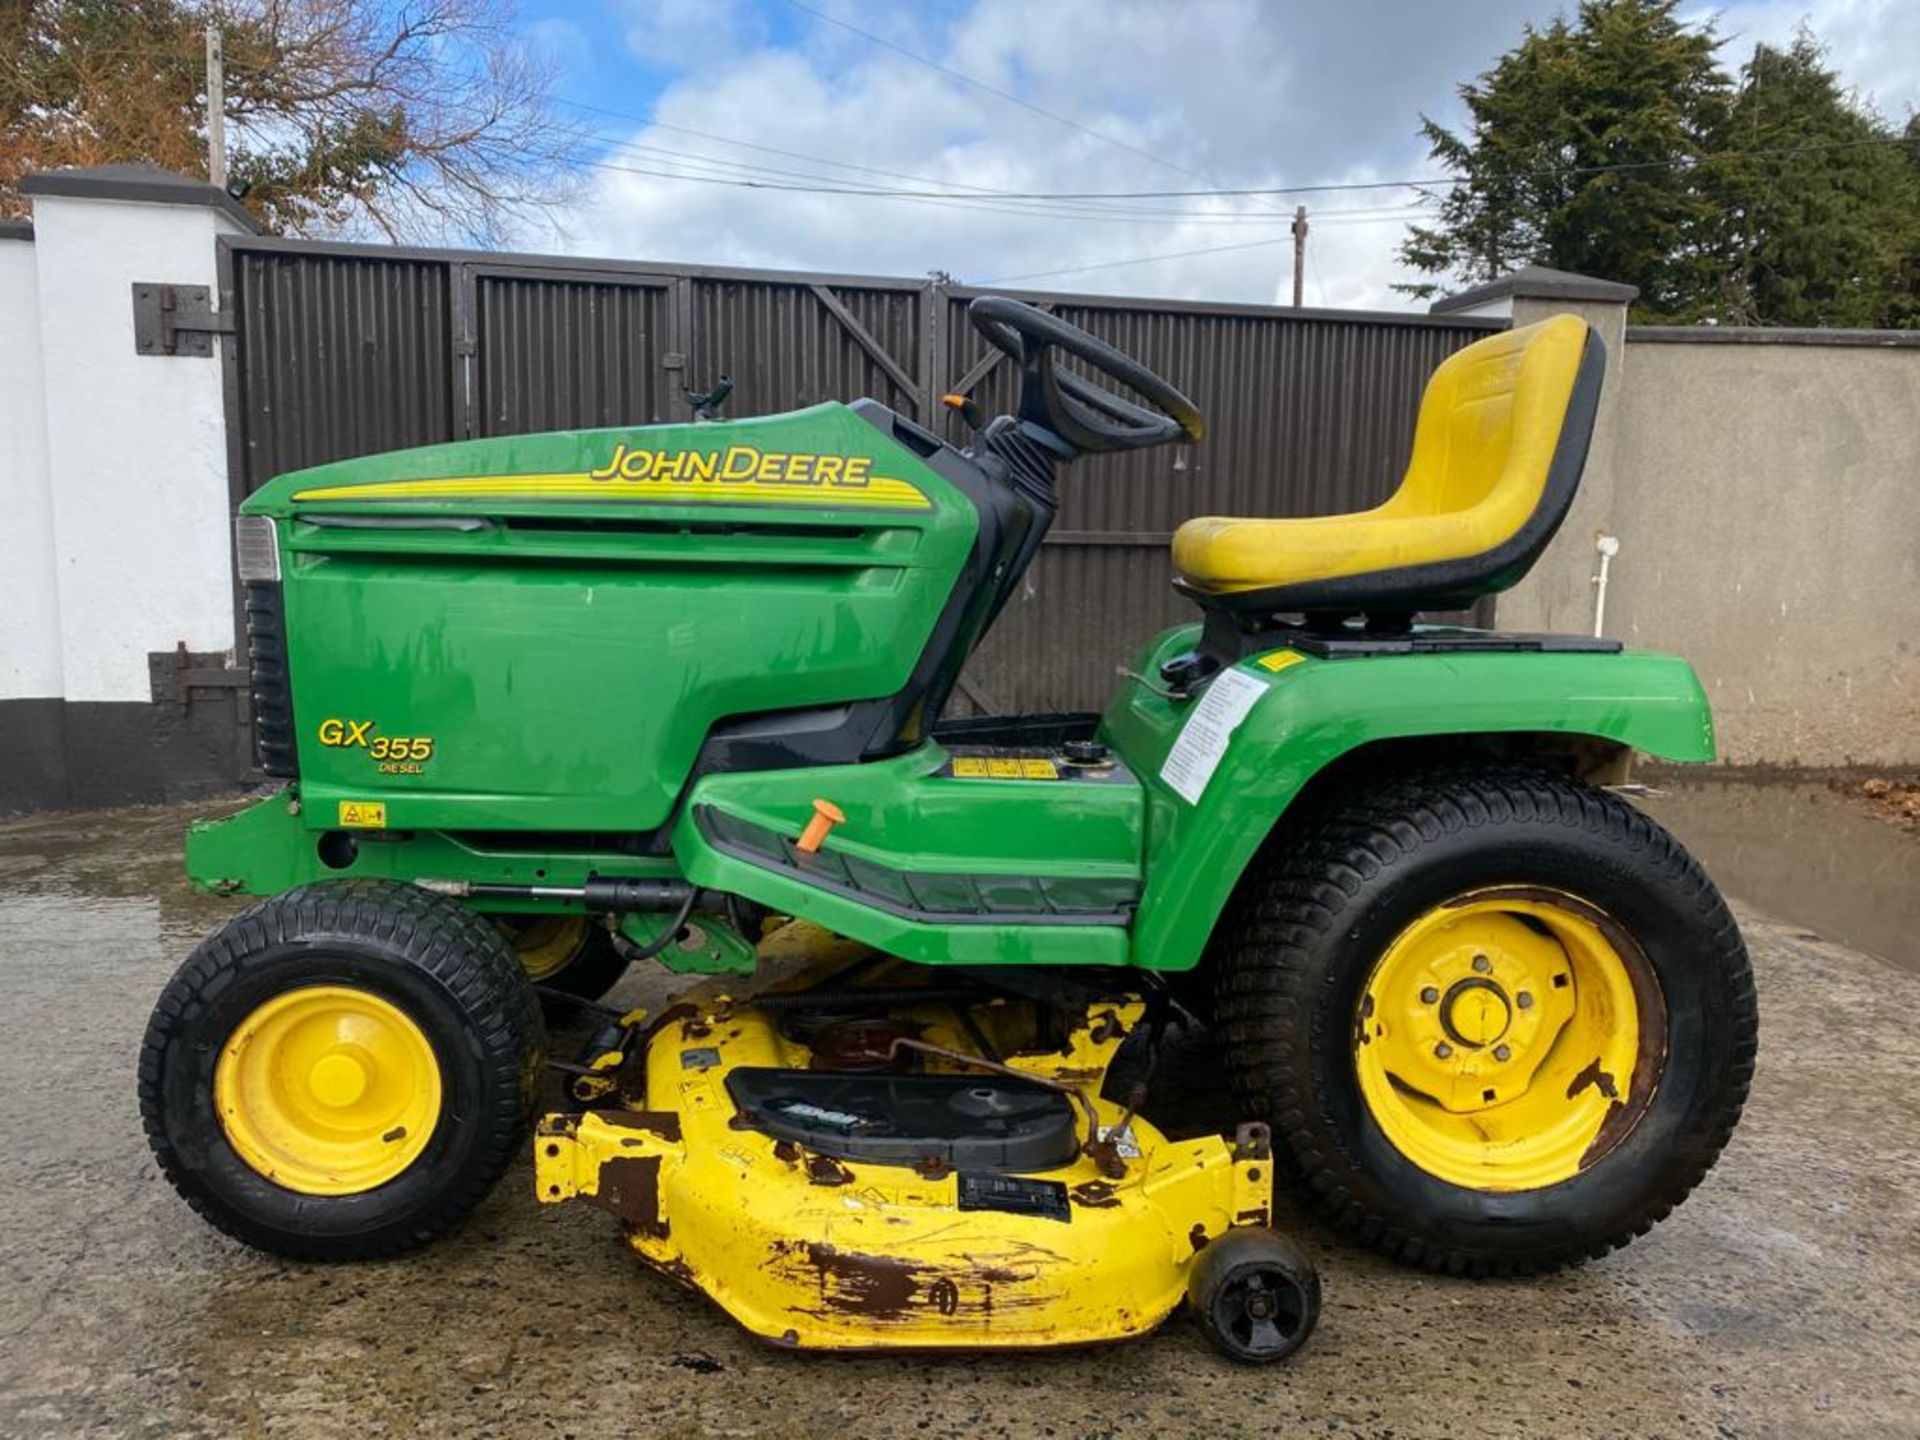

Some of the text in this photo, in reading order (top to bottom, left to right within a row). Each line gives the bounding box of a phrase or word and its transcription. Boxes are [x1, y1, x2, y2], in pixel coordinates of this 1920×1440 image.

[591, 444, 872, 487] JOHN DEERE
[319, 718, 433, 761] GX 355
[378, 762, 424, 774] DIESEL
